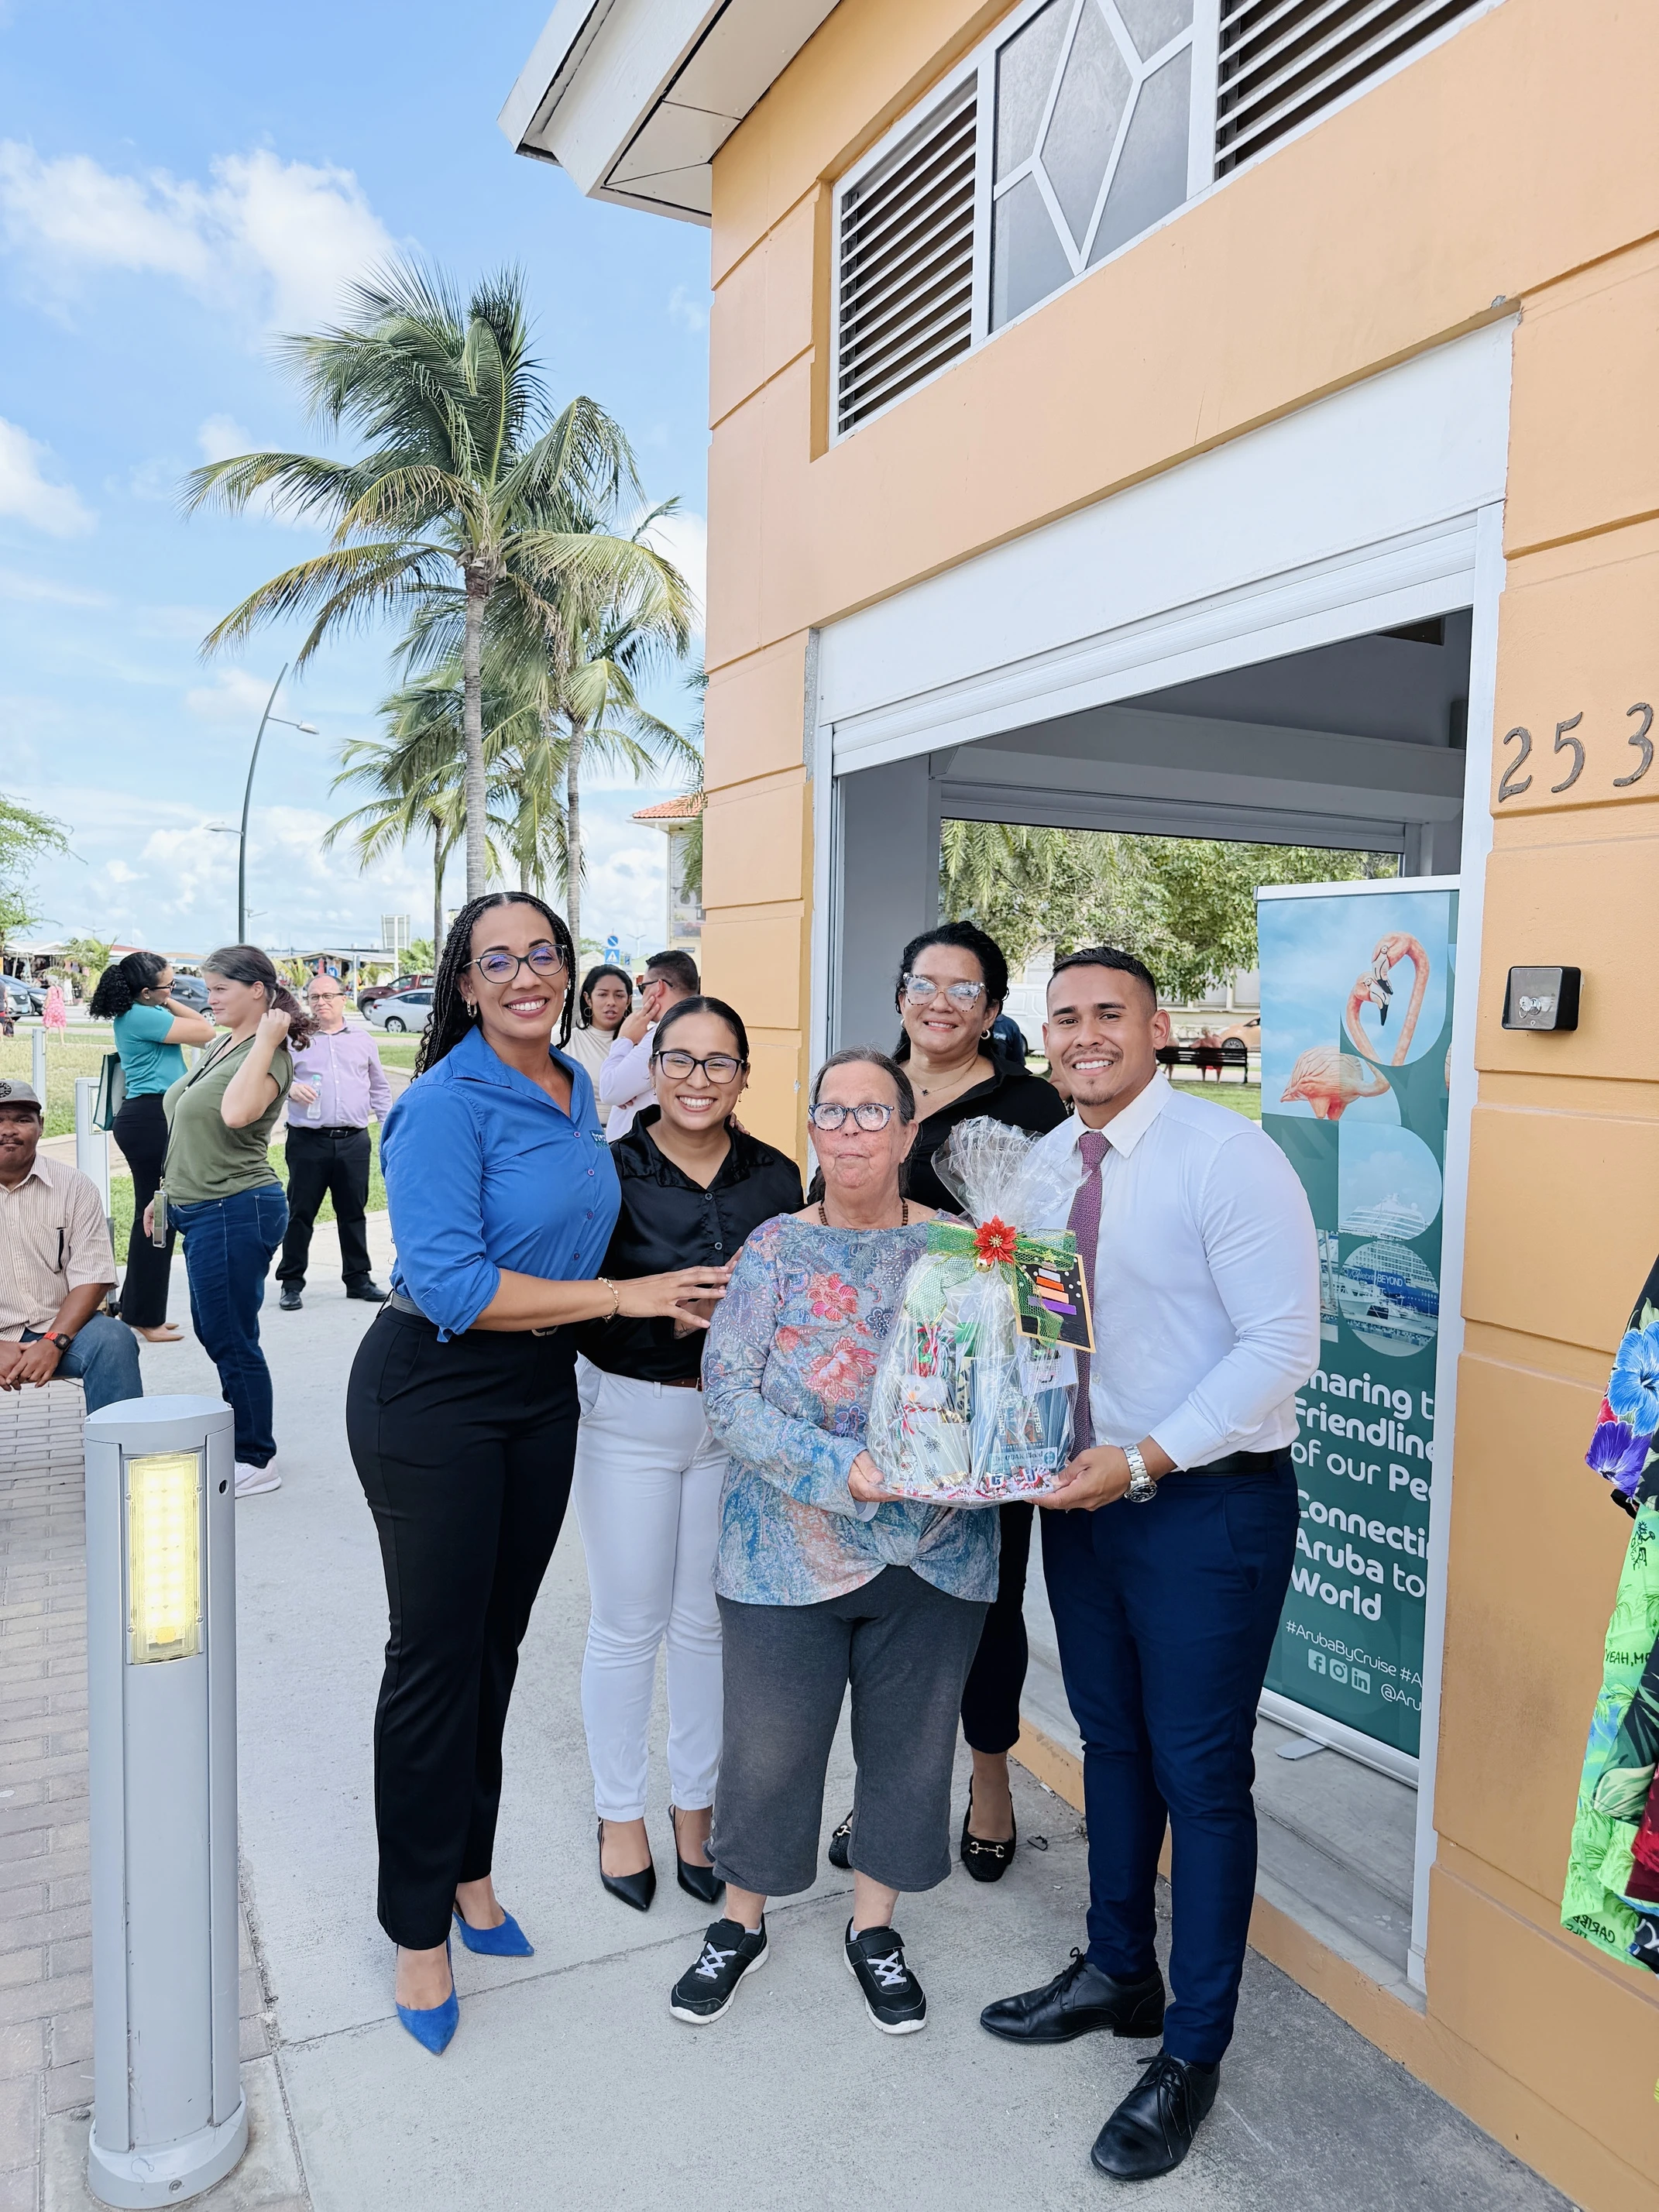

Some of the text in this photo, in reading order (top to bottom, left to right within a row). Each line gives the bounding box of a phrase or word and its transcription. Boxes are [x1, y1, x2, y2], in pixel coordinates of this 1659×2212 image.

[1499, 702, 1654, 803] 253
[1378, 1273, 1403, 1287] BEYOND
[1303, 1369, 1412, 1420] haring
[1290, 1438, 1432, 1503] of our Pe
[1297, 1489, 1429, 1561] Connecti
[1290, 1564, 1382, 1621] World
[1295, 1527, 1426, 1598] Aruba to
[1286, 1620, 1397, 1677] #ArubaByCruise
